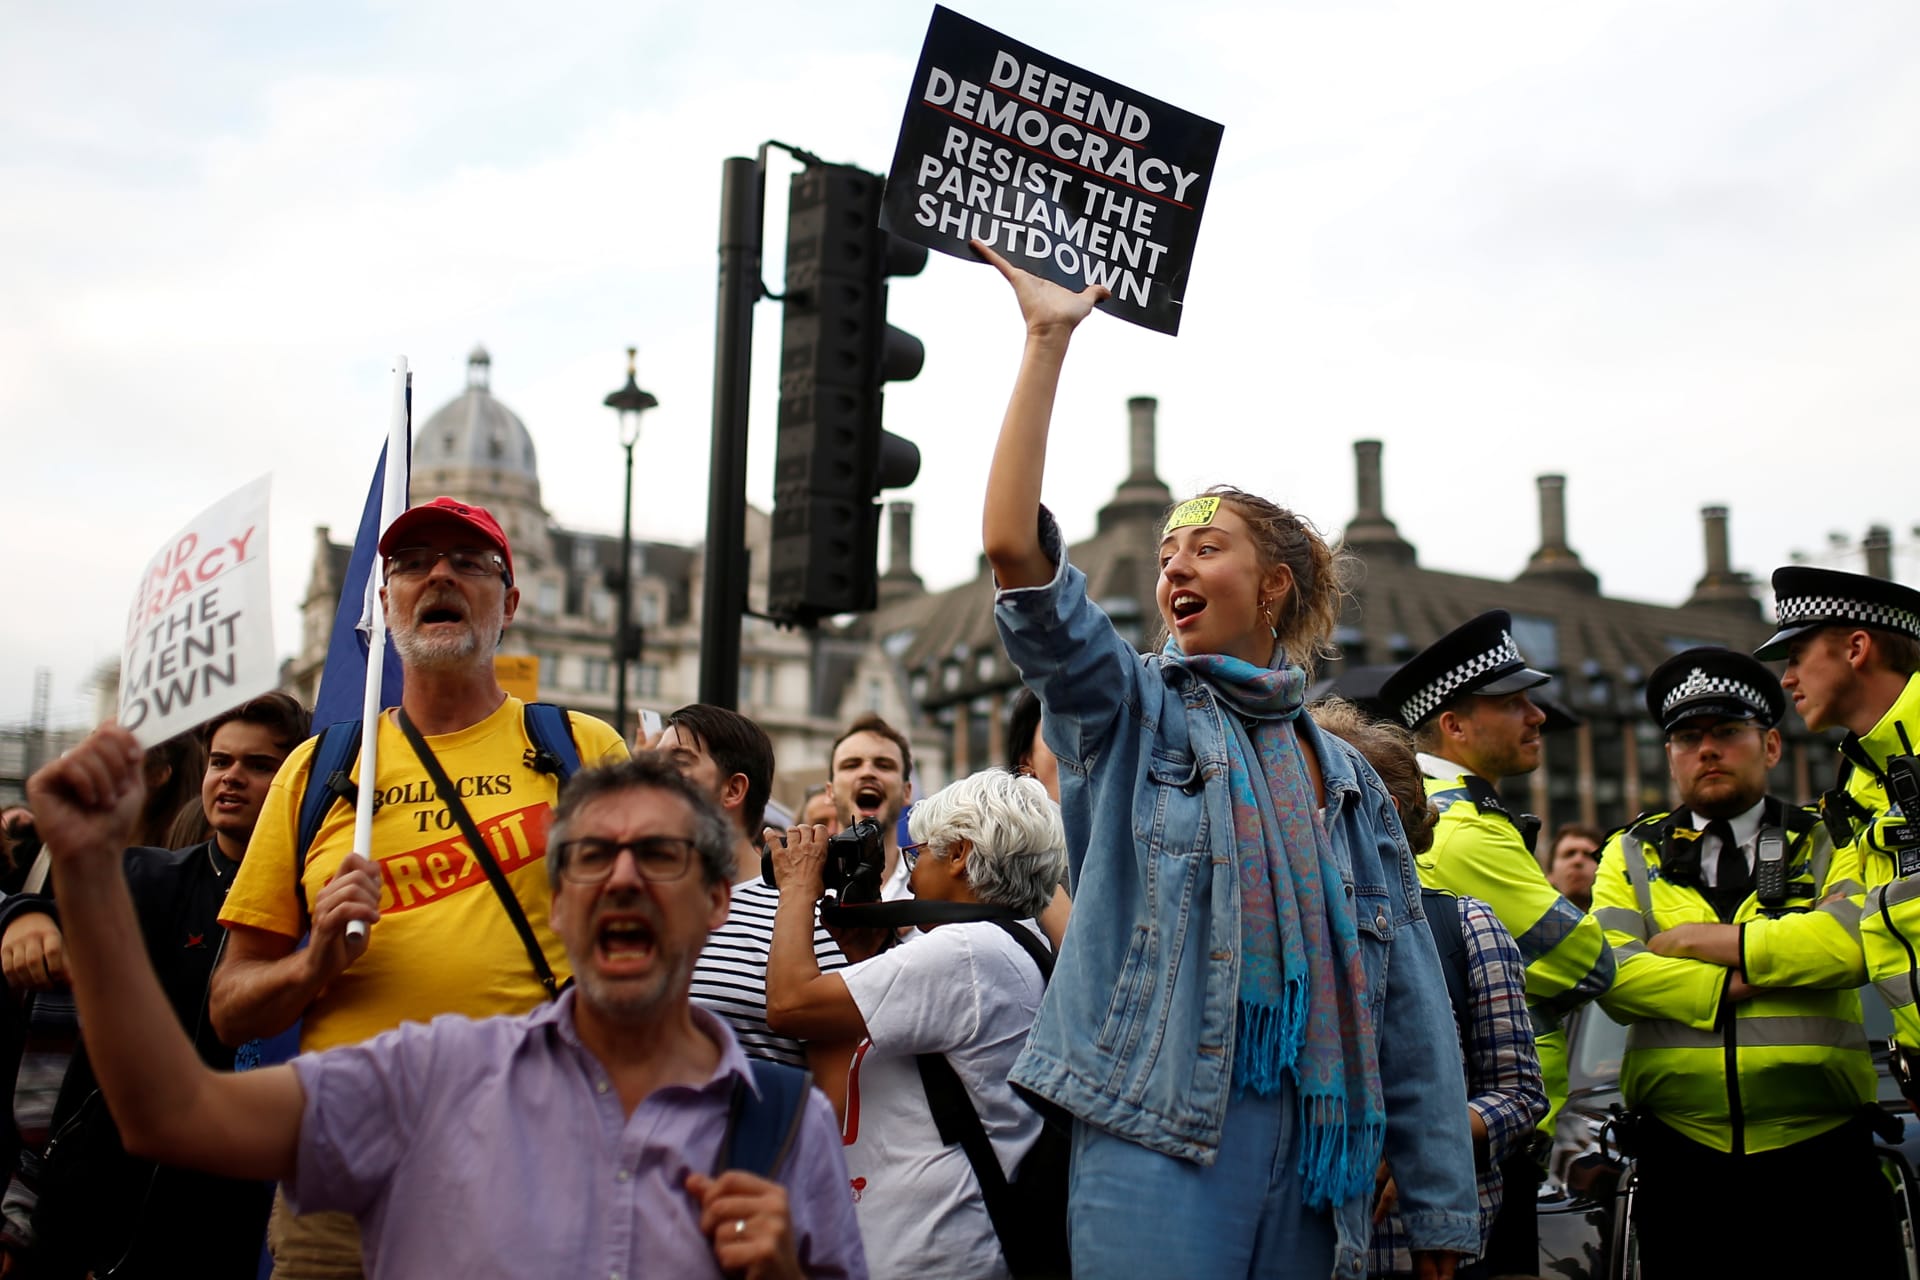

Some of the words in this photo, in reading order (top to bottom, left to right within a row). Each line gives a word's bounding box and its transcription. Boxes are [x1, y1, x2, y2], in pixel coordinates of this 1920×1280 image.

[923, 66, 1200, 203] DEMOCRACY
[989, 50, 1151, 142] DEFEND
[917, 154, 1169, 275] PARLIAMENT
[942, 126, 1073, 203] RESIST
[1082, 180, 1157, 237] THE
[914, 193, 1152, 308] SHUTDOWN
[147, 587, 219, 656] THE
[373, 774, 512, 808] BOLLCKS
[414, 808, 455, 832] TO
